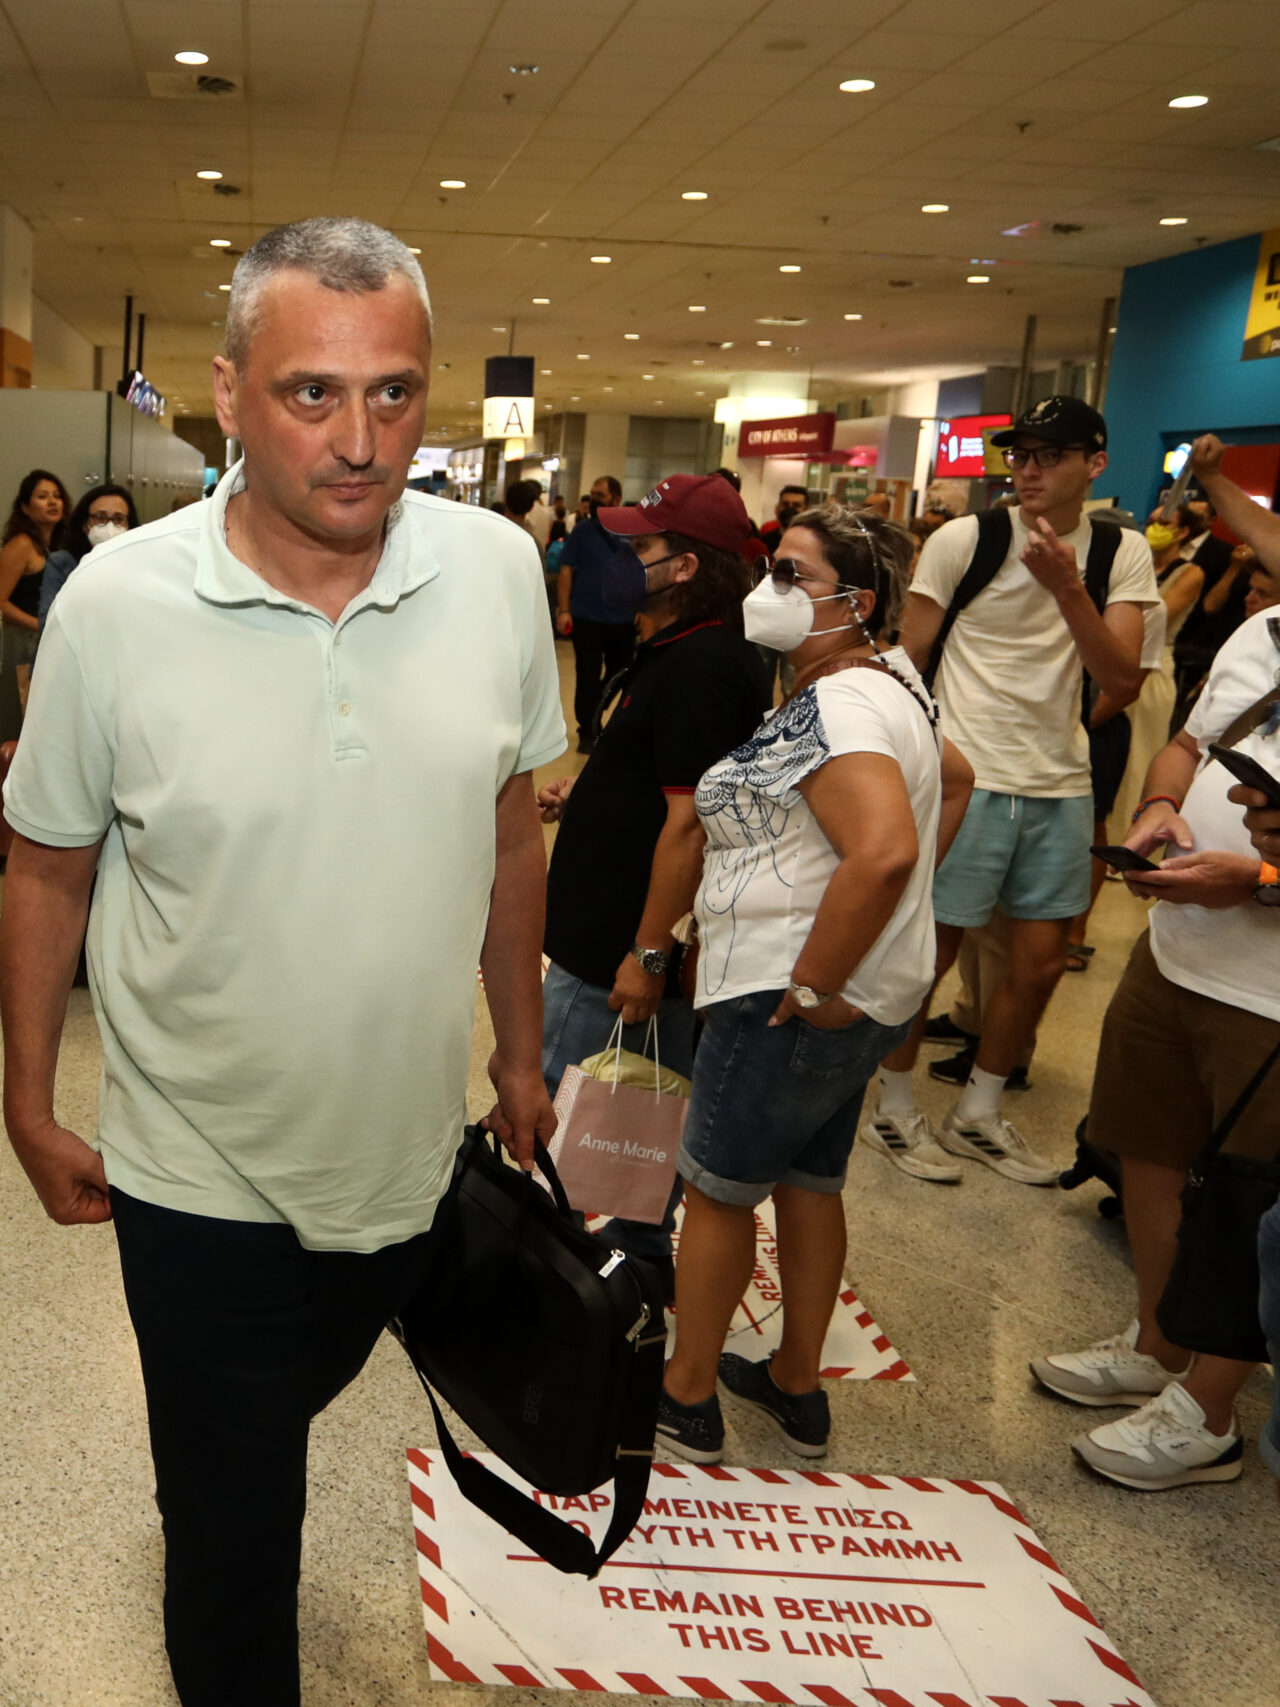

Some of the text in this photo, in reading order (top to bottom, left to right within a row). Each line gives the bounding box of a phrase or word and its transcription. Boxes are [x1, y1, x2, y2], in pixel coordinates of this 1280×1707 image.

[503, 402, 524, 434] A
[578, 1132, 620, 1154] Anne
[623, 1140, 667, 1163] Marie
[531, 1490, 913, 1530] ΠΑΡΜΕΙΝΕΤΕ ΠΙΣΩ
[723, 1529, 780, 1552] ΤΗ
[787, 1533, 963, 1562] ΓΡΑΜΜΗ
[599, 1586, 933, 1628] REMAIN BEHIND
[668, 1623, 883, 1660] THIS LINE
